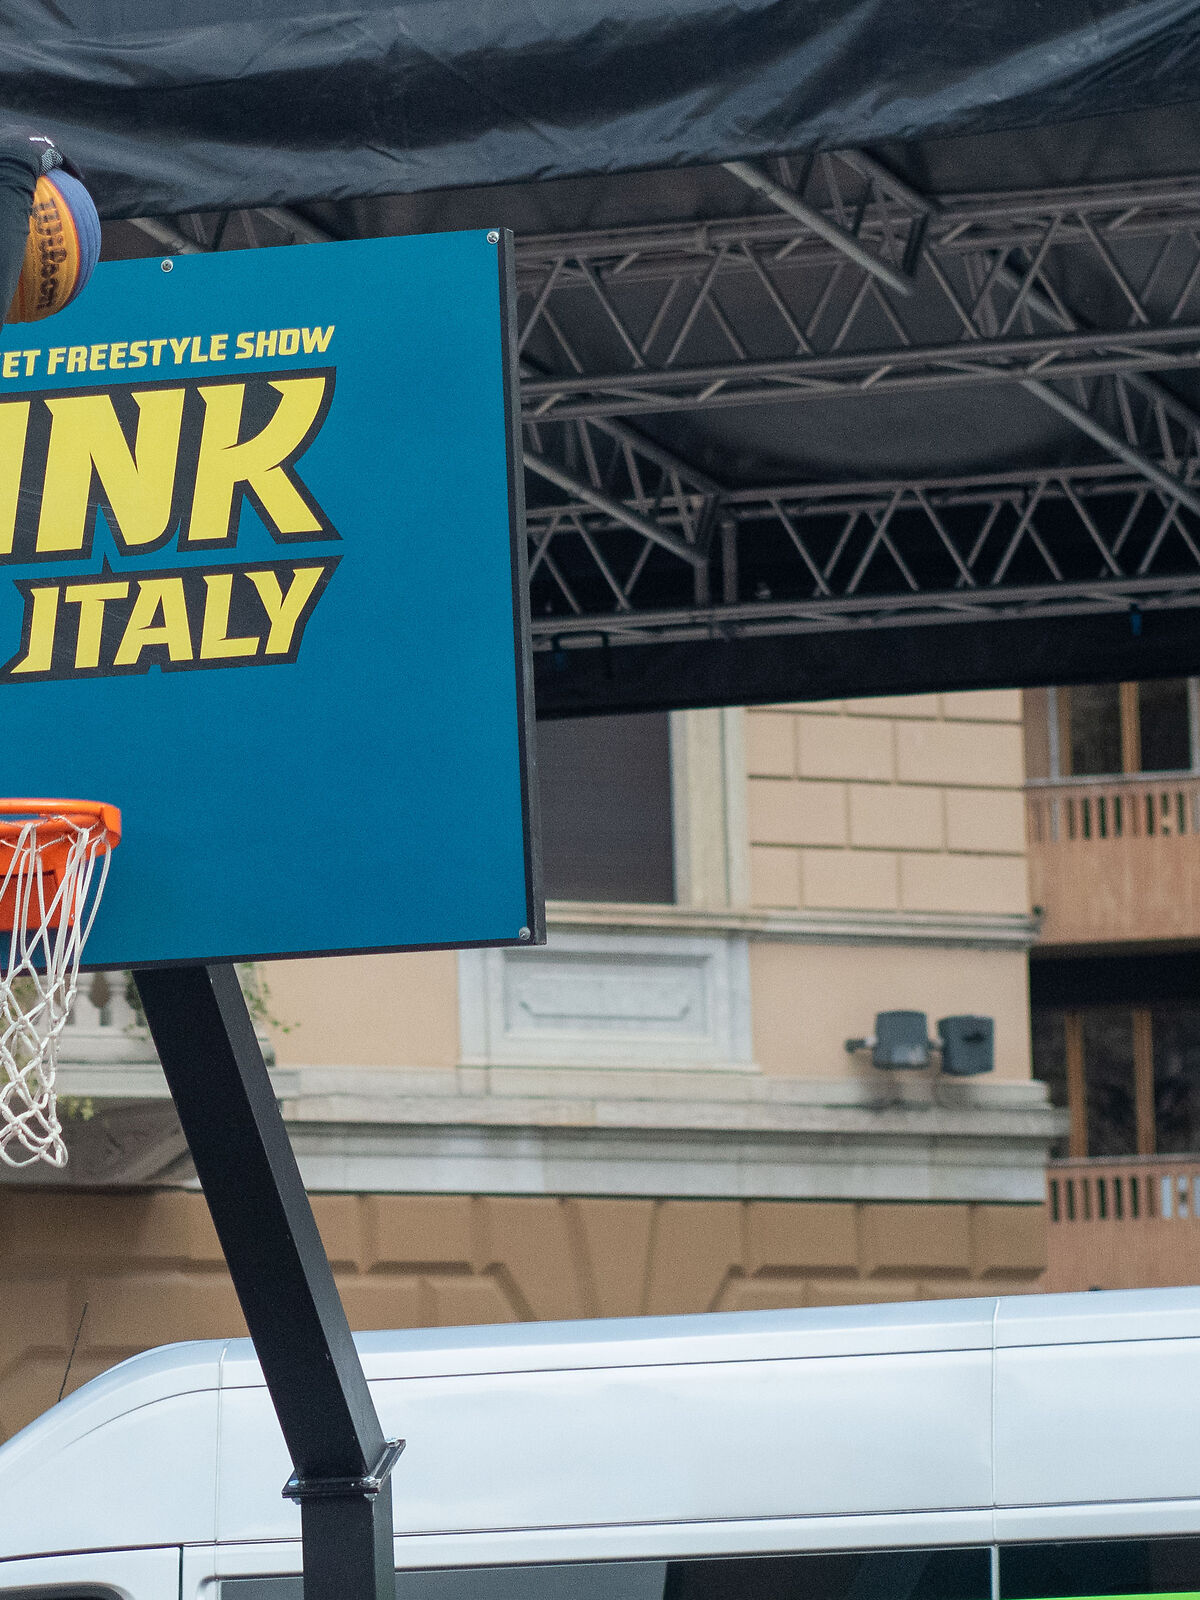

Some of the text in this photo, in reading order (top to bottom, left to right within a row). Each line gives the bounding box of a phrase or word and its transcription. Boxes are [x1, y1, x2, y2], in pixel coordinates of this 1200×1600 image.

[47, 334, 228, 375] FREESTYLE
[235, 326, 335, 359] SHOW
[10, 566, 325, 674] ITALY
